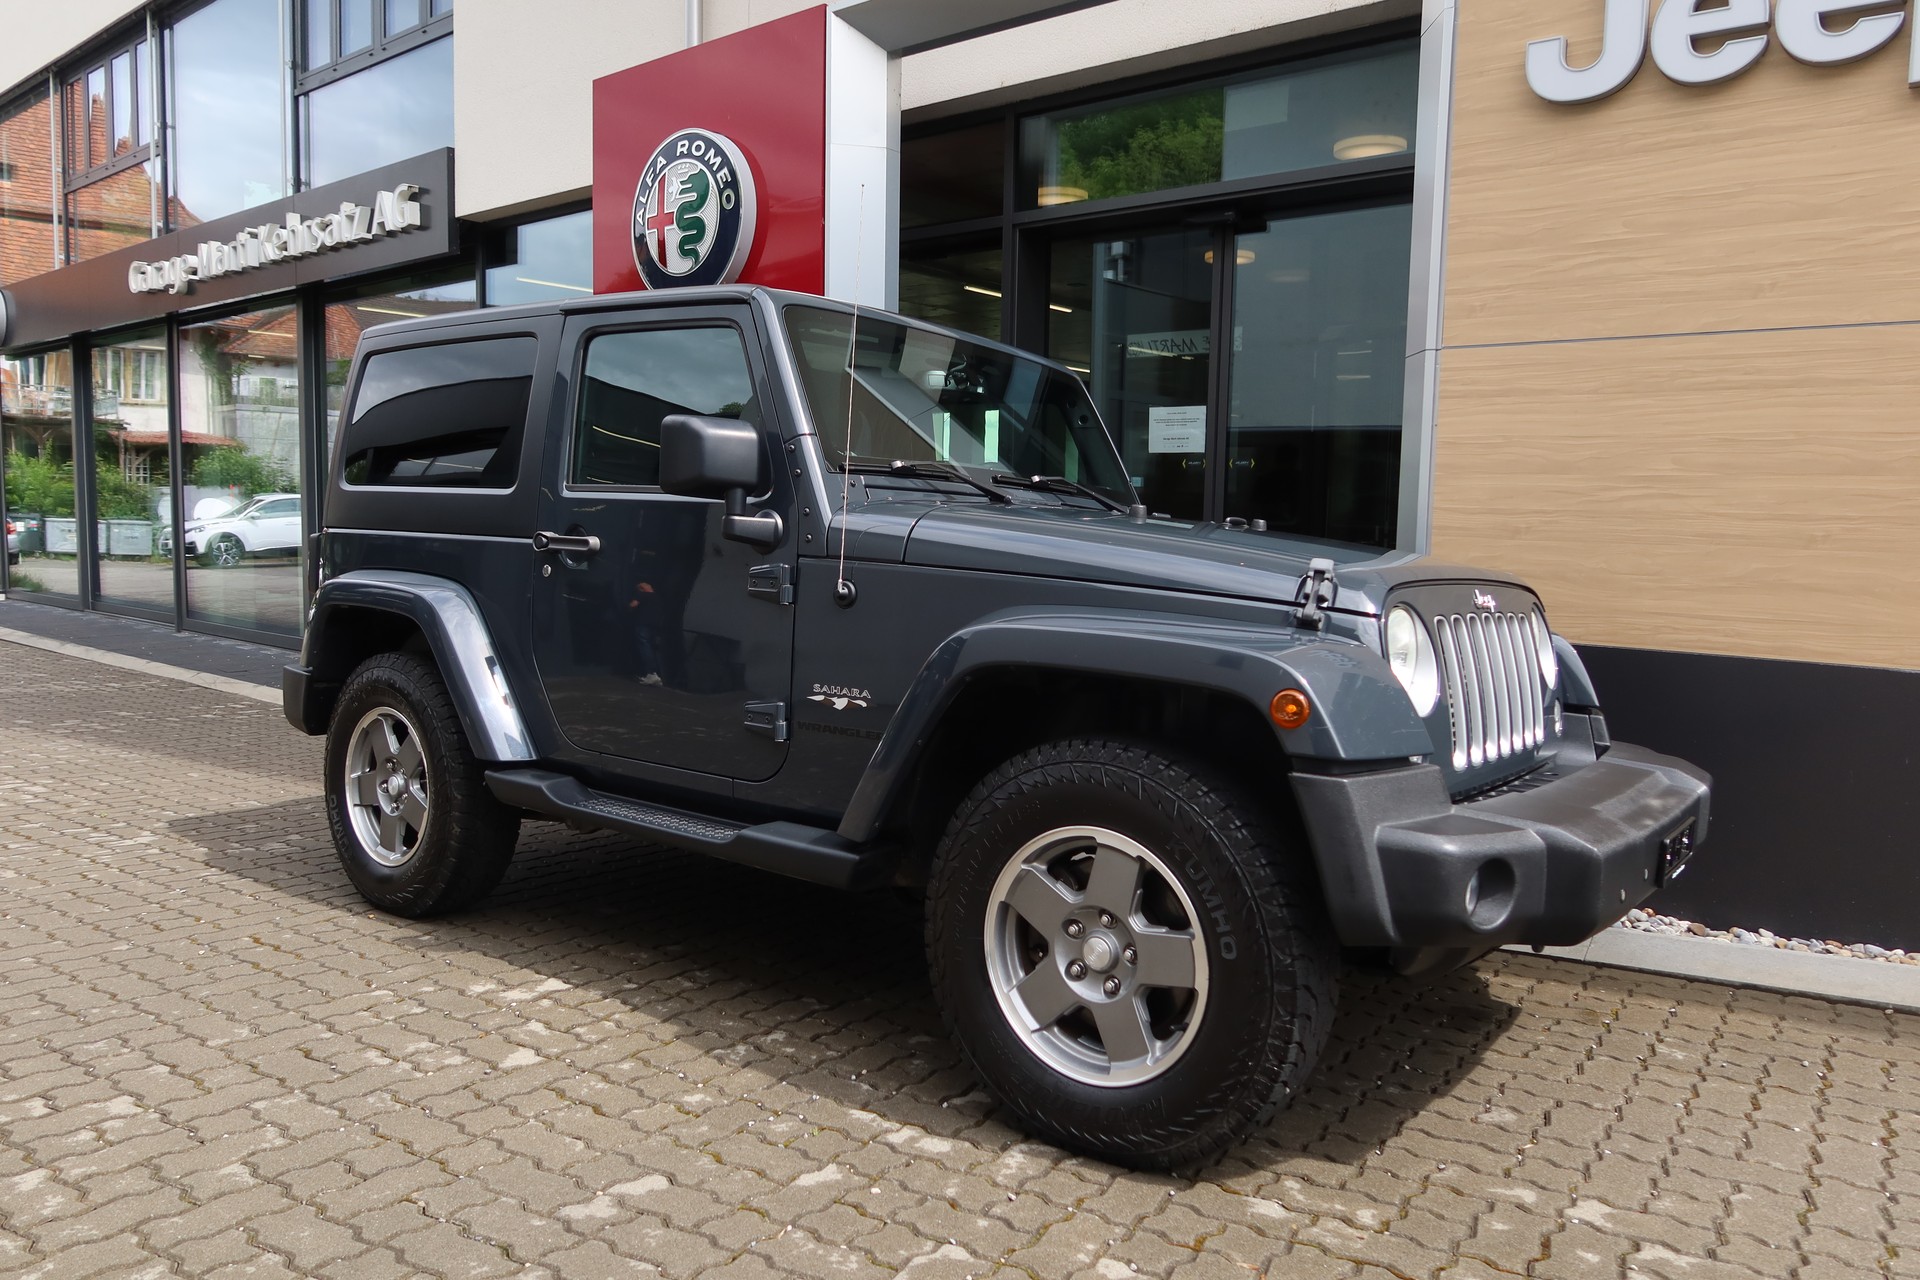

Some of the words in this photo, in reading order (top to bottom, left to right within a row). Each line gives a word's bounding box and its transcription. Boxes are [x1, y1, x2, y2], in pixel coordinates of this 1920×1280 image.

[1525, 0, 1920, 104] Jee
[636, 155, 668, 226] ALFA
[676, 140, 736, 210] ROMEO
[128, 254, 197, 295] Garage
[197, 228, 259, 280] Marti
[257, 200, 374, 264] Kehrsatz
[372, 183, 421, 236] AG
[812, 683, 872, 699] SAHARA
[1164, 831, 1238, 961] KUMHO
